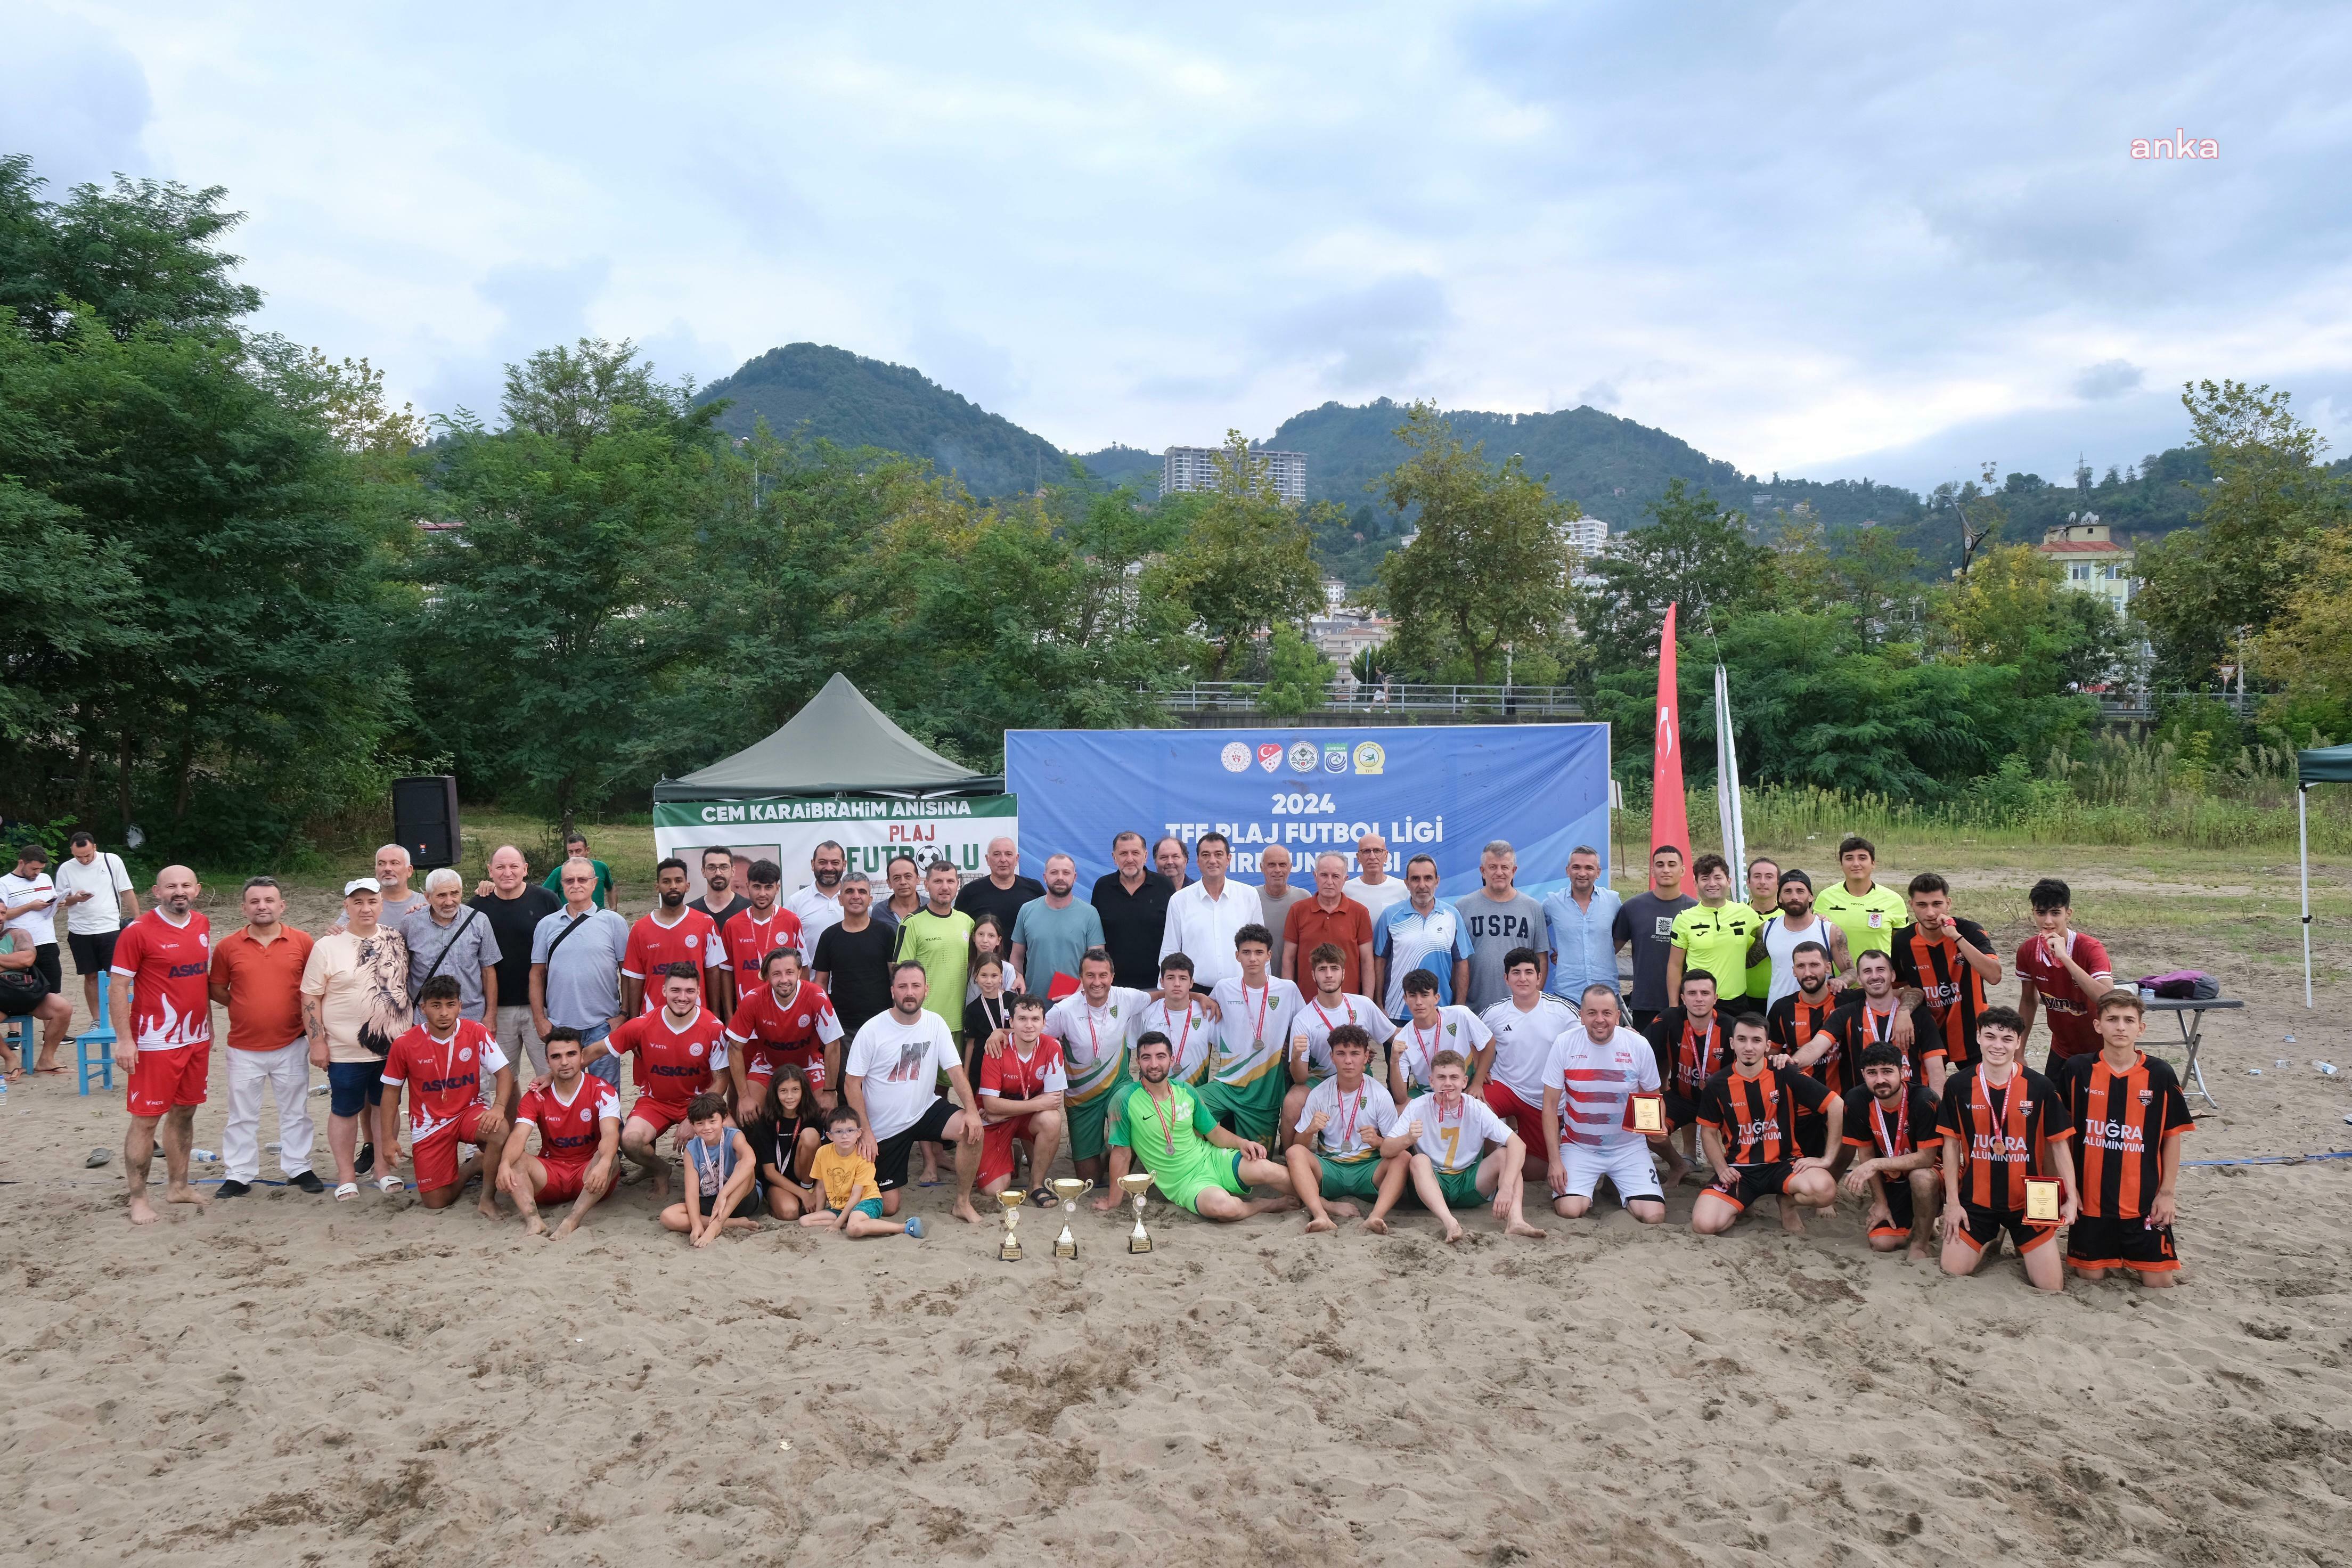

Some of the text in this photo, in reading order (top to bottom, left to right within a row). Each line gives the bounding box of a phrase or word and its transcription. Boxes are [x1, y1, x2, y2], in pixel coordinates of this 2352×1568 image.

[701, 806, 745, 822] CEM
[892, 801, 971, 817] ANISINA
[1271, 793, 1336, 814] 2024
[889, 824, 935, 842] PLAJ
[1165, 815, 1442, 844] TFF PLAJ FUTBOL LİGİ
[1229, 846, 1323, 873] İRUN
[1471, 915, 1528, 939] USPA
[1923, 982, 1960, 999] TUĞR
[650, 1064, 700, 1076] ASKON
[422, 1073, 475, 1092] ASKON
[1738, 1118, 1779, 1137] TUĞRA
[2086, 1119, 2143, 1140] TUĞRA
[1441, 1127, 1459, 1167] 7
[1737, 1132, 1782, 1145] ALÜMİNYUM
[2083, 1136, 2144, 1153] ALÜMİNYUM
